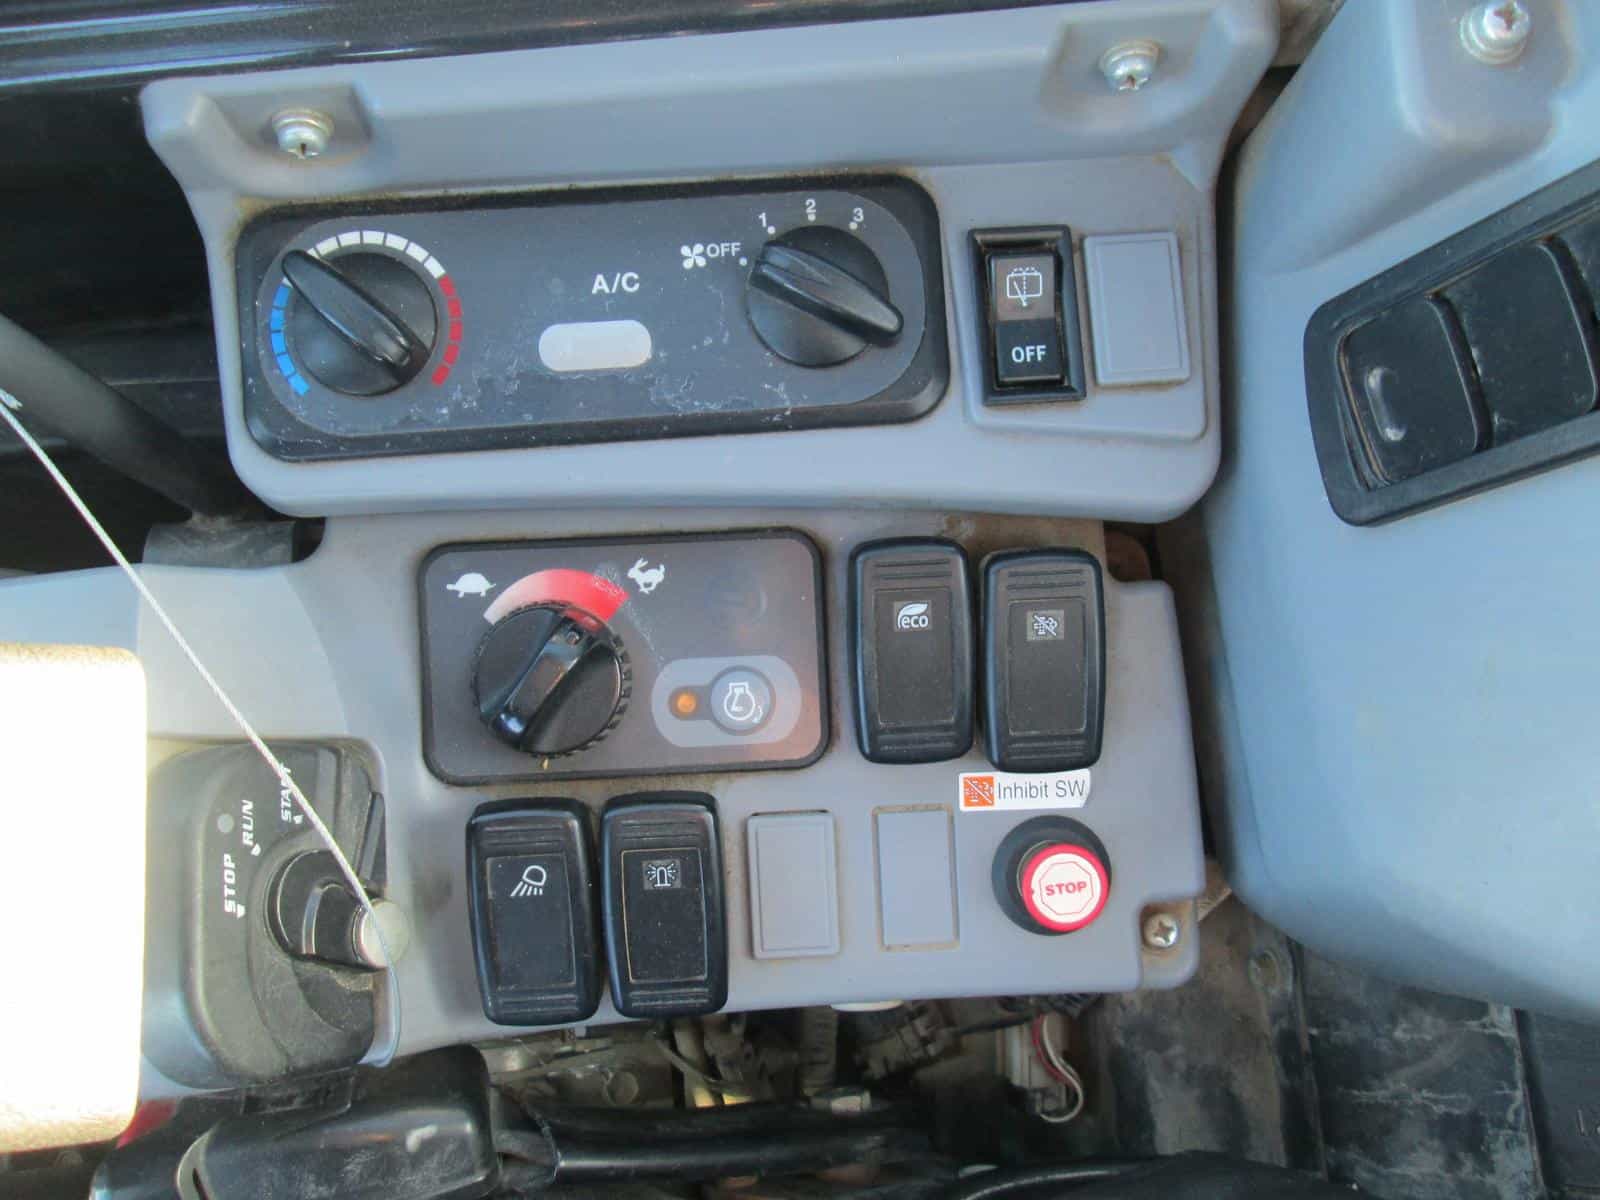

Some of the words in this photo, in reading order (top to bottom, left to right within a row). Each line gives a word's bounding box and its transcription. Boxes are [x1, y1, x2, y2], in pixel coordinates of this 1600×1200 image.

[805, 198, 816, 214] 2
[758, 212, 767, 227] 1
[853, 207, 864, 222] 3
[706, 243, 741, 258] OFF
[591, 271, 640, 294] A/C
[1011, 345, 1047, 363] OFF
[901, 614, 928, 629] eco
[998, 782, 1048, 799] Inhibit
[1055, 780, 1086, 798] SW
[242, 799, 254, 846] RUN
[223, 853, 236, 914] STOP
[1045, 880, 1087, 896] STOP
